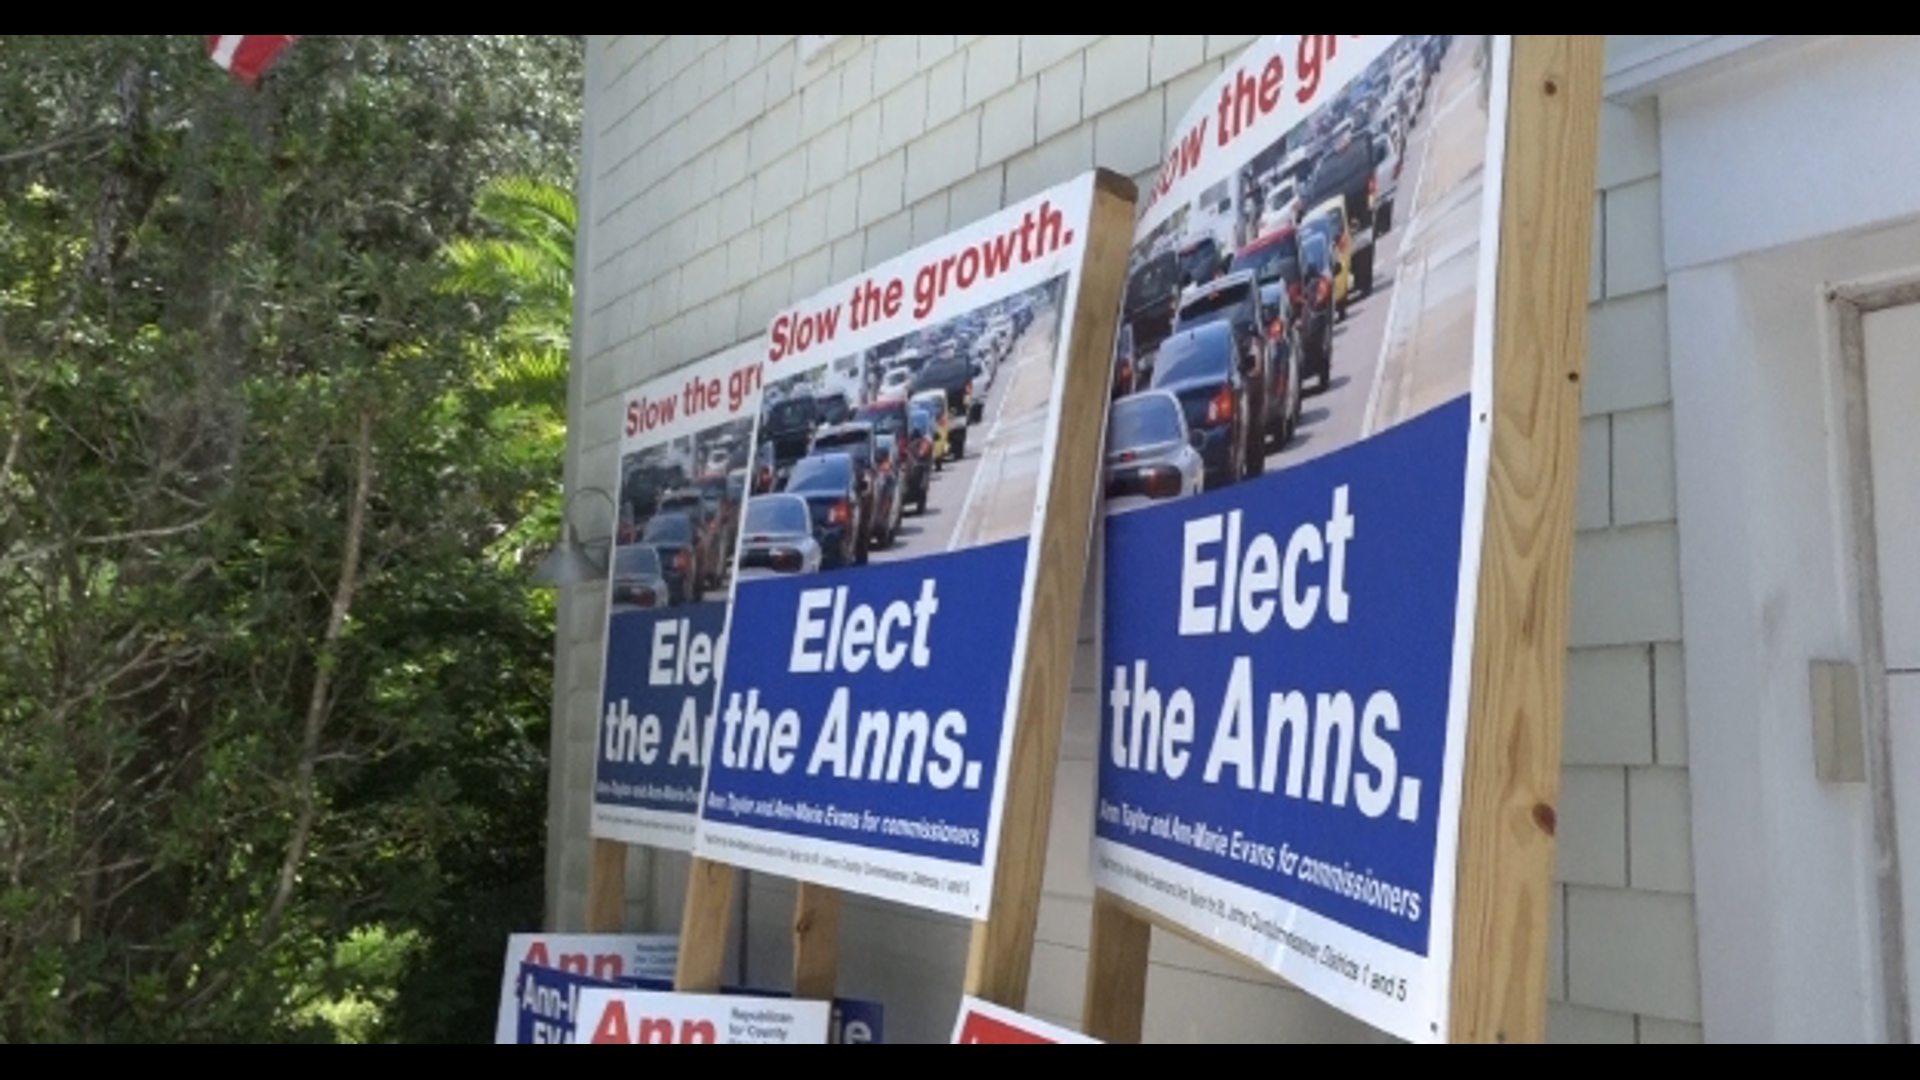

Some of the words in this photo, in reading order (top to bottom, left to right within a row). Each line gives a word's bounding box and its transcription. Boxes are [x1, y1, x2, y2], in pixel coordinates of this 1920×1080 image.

[1217, 53, 1285, 148] the
[769, 300, 842, 363] Slow
[848, 278, 902, 331] the
[914, 200, 1076, 320] growth.
[626, 394, 678, 436] Slow
[683, 376, 721, 416] the
[729, 362, 763, 411] gr
[1178, 483, 1355, 636] Elect
[788, 578, 940, 674] Elect
[604, 698, 661, 766] the
[721, 687, 800, 775] the
[805, 686, 983, 790] Anns.
[1109, 659, 1195, 781] the
[1203, 656, 1422, 823] Anns.
[824, 803, 860, 830] Evans
[861, 809, 881, 833] for
[881, 815, 980, 848] commissioners
[1122, 802, 1151, 835] Taylor
[1151, 814, 1173, 840] and
[1172, 815, 1229, 858] Ann-Marie
[1229, 830, 1276, 870] Evans
[1277, 842, 1300, 877] for
[1297, 855, 1422, 923] commissioners
[525, 940, 623, 980] Ann
[1370, 972, 1395, 998] and
[1396, 978, 1408, 1002] 5
[590, 999, 716, 1044] Ann
[728, 1024, 745, 1036] for
[730, 1007, 795, 1024] Republican
